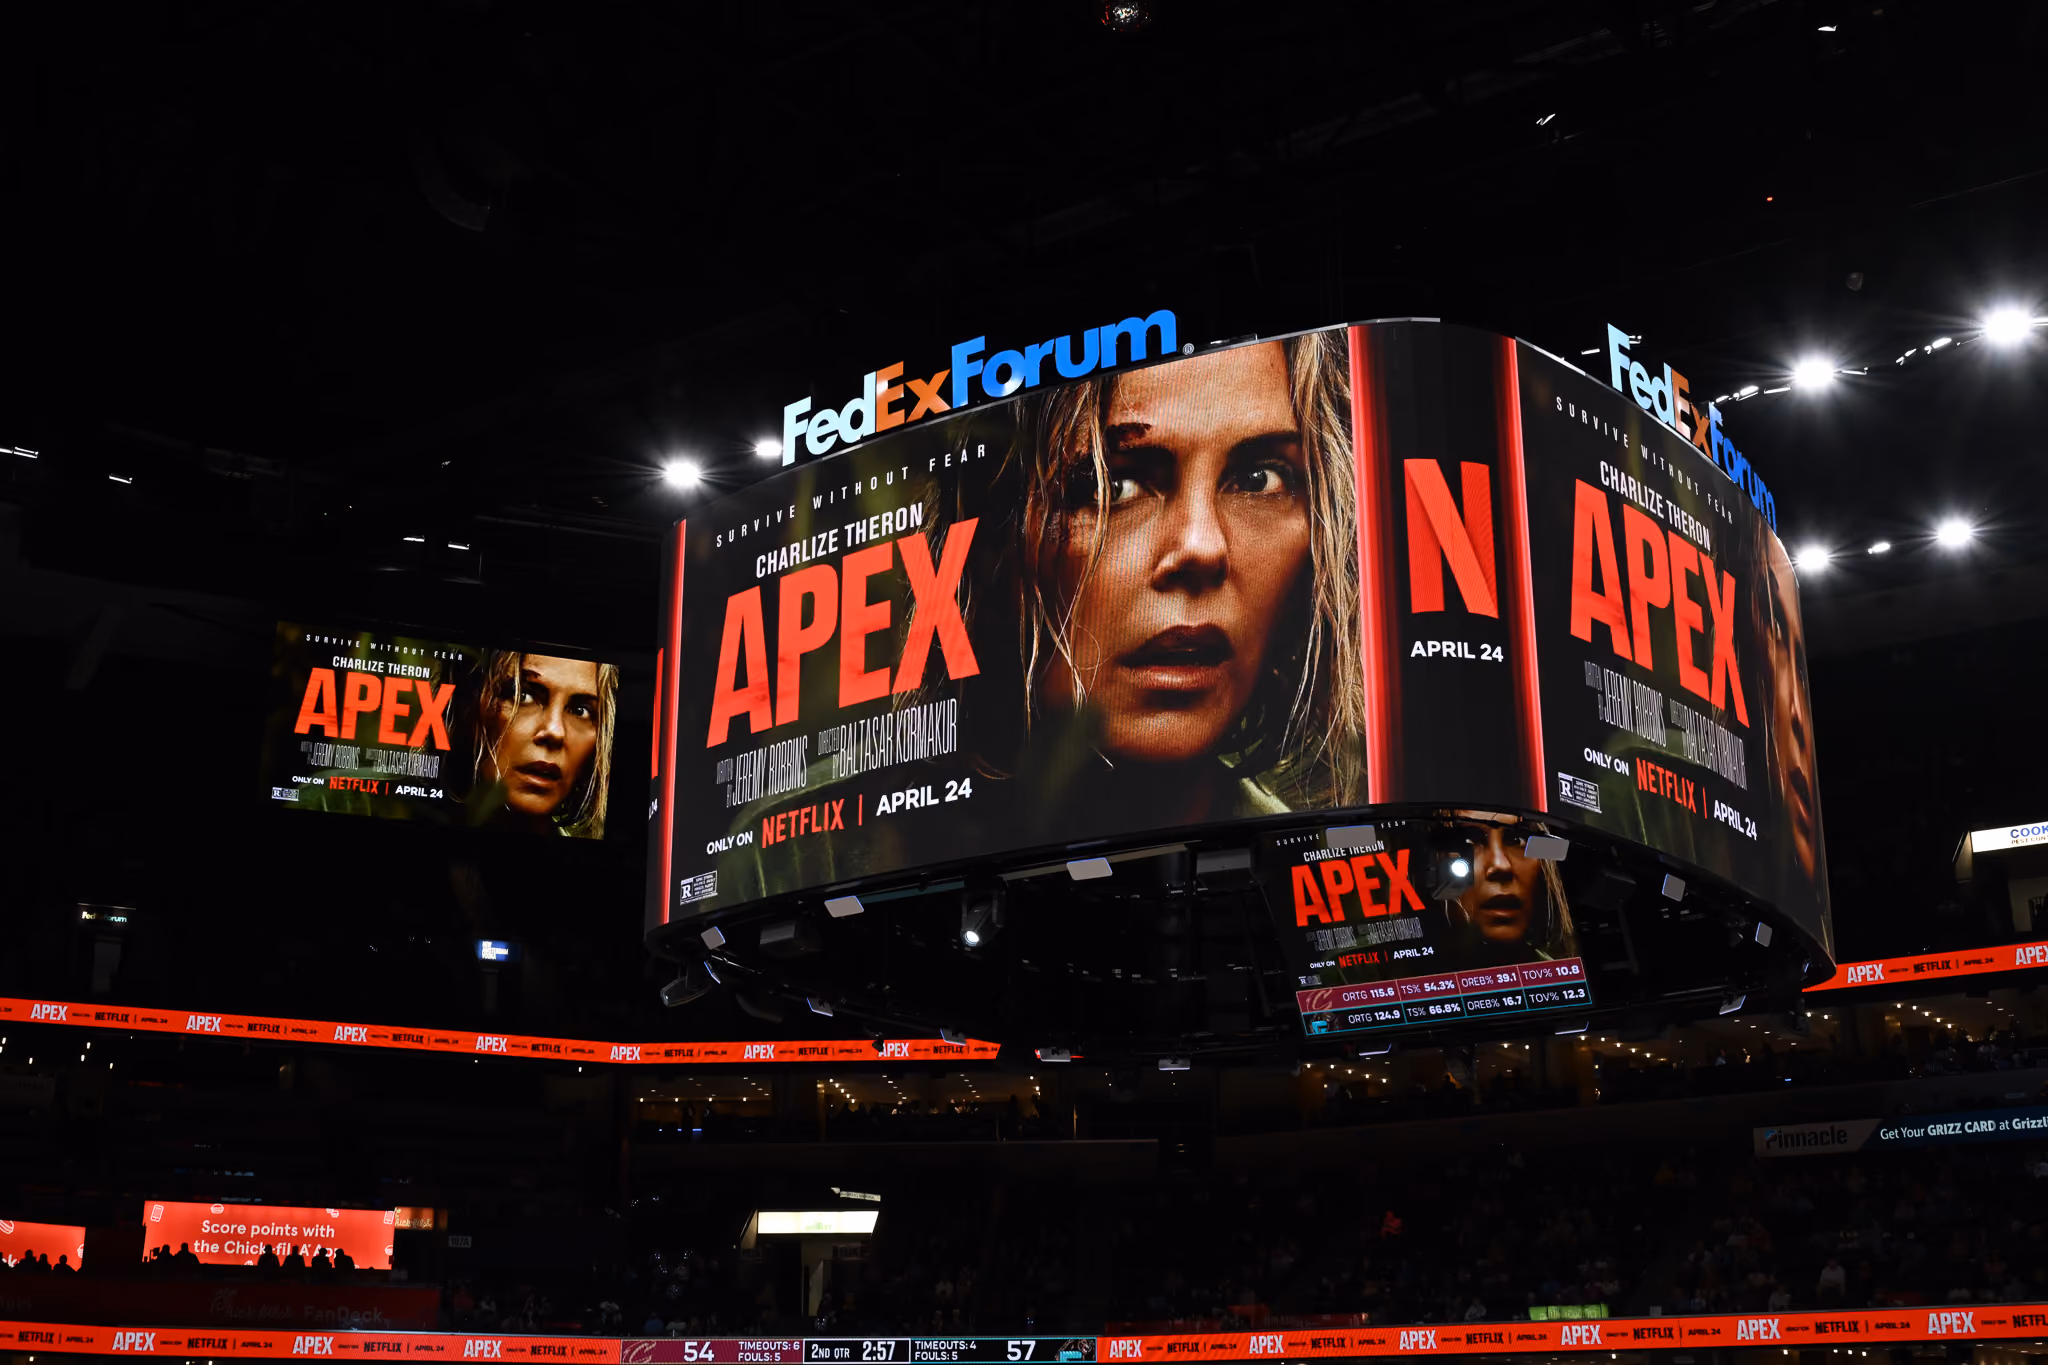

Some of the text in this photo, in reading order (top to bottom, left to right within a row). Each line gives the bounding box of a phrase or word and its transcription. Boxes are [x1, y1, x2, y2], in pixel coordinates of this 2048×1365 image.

[782, 309, 1177, 466] FedExForum
[1607, 323, 1776, 532] FedExForum
[1556, 397, 1732, 523] SURVIVE WITHOUT FEAR
[717, 444, 985, 548] SURVIVE WITHOUT FEAR
[1600, 461, 1711, 550] CHARLIZE THERON
[756, 502, 923, 578] CHARLIZE THERON
[1404, 458, 1498, 619] N
[1570, 478, 1749, 728] APEX
[707, 517, 980, 748] APEX
[306, 634, 463, 661] SURVIVE WITHOUT FEAR
[1411, 641, 1504, 662] APRIL 24
[333, 656, 430, 678] CHARLIZE THERON
[294, 667, 456, 751] APEX
[840, 698, 957, 778] BALTASAR KORMAKUR
[733, 747, 767, 806] JEREMY
[768, 735, 808, 796] ROBBINS
[292, 775, 443, 799] ONLY ON NETFLIX APRIL 24
[1560, 780, 1572, 798] R
[1584, 748, 1757, 841] ONLY ON NETFLIX APRIL 24
[706, 778, 972, 855] ONLY ON NETFLIX APRIL 24
[682, 885, 691, 899] R
[1291, 849, 1426, 927] APEX
[1338, 952, 1379, 968] NETFLIX
[1393, 948, 1420, 960] APRIL
[1422, 946, 1434, 956] 24
[1461, 972, 1518, 988] OREB% 39.1
[1523, 965, 1580, 980] TOV% 10.8
[1847, 963, 1884, 983] APEX
[1913, 959, 1951, 974] NETFLIX
[1342, 987, 1394, 1002] ORTG 115.6
[1401, 980, 1455, 995] TS% 54.3%
[1529, 988, 1586, 1004] TOV% 12.3
[1406, 1002, 1461, 1018] TS% 66.8%
[1467, 995, 1522, 1011] OREB% 16.7
[1348, 1009, 1401, 1025] ORTG 124.9
[31, 1003, 68, 1021] APEX
[186, 1015, 221, 1032] APEX
[334, 1025, 368, 1042] APEX
[476, 1036, 507, 1053] APEX
[610, 1045, 641, 1061] APEX
[744, 1044, 775, 1060] APEX
[1765, 1125, 1847, 1149] Pinnacle
[1880, 1129, 1899, 1141] Get
[1901, 1127, 1925, 1138] Your
[1927, 1123, 1962, 1137] GRIZZ
[1964, 1120, 1996, 1134] CARD
[1999, 1120, 2010, 1131] at
[202, 1220, 335, 1239] Score points with
[194, 1240, 219, 1254] the
[18, 1331, 566, 1358] NETFLIX APEX NETFLIX APEX NETFLIX APEX NETFLIX
[738, 1341, 800, 1350] TIMEOUTS: 6
[915, 1341, 977, 1350] TIMEOUTS: 4
[1109, 1340, 1142, 1358] APEX
[1167, 1342, 1199, 1353] NETFLIX
[1249, 1335, 1284, 1354] APEX
[1311, 1337, 1346, 1349] NETFLIX
[1399, 1330, 1437, 1350] APEX
[1466, 1332, 1504, 1344] NETFLIX
[1561, 1325, 1602, 1345] APEX
[1633, 1327, 1674, 1340] NETFLIX
[1737, 1319, 1781, 1340] APEX
[1815, 1320, 1859, 1334] NETFLIX
[1928, 1312, 1976, 1334] APEX
[684, 1342, 714, 1361] 54
[738, 1353, 781, 1361] FOULS: 5
[811, 1343, 850, 1359] 2ND QTR
[862, 1341, 895, 1361] 2:57
[915, 1352, 958, 1360] FOULS: 5
[1007, 1341, 1036, 1361] 57
